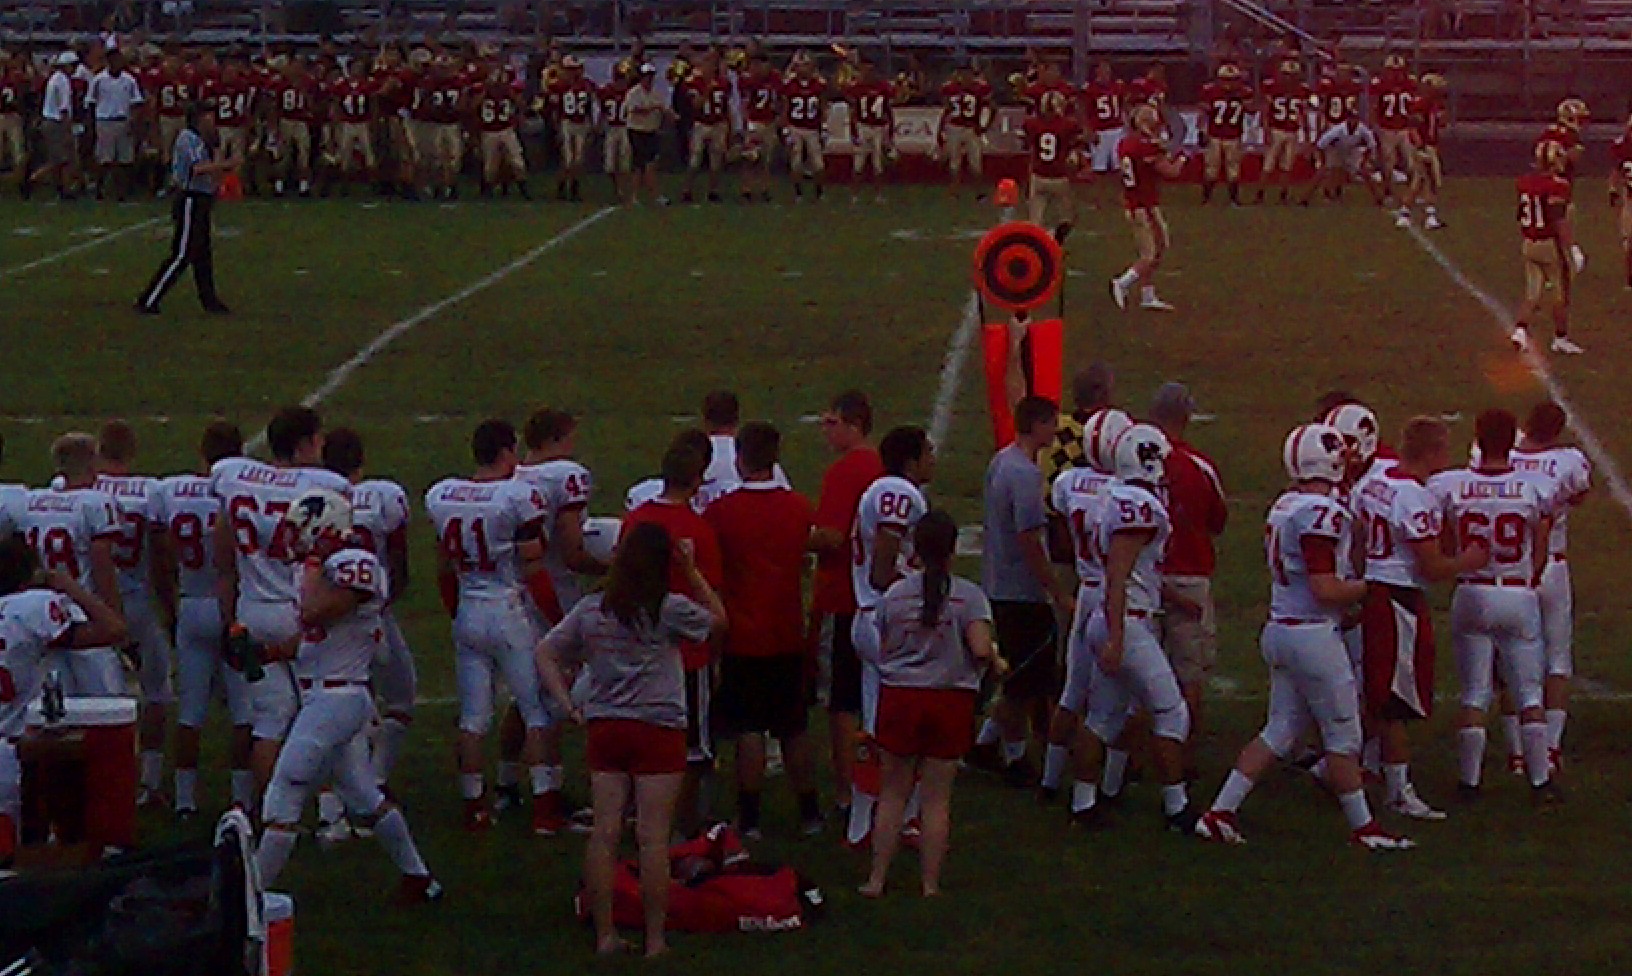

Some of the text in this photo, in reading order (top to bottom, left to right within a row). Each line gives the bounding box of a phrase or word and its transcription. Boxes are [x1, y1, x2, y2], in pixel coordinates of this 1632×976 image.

[1211, 99, 1243, 125] 77
[1039, 132, 1058, 162] 9
[1518, 191, 1546, 229] 31
[880, 491, 912, 519] 80
[444, 517, 496, 573] 41
[1459, 512, 1527, 564] 69
[338, 558, 376, 585] 56
